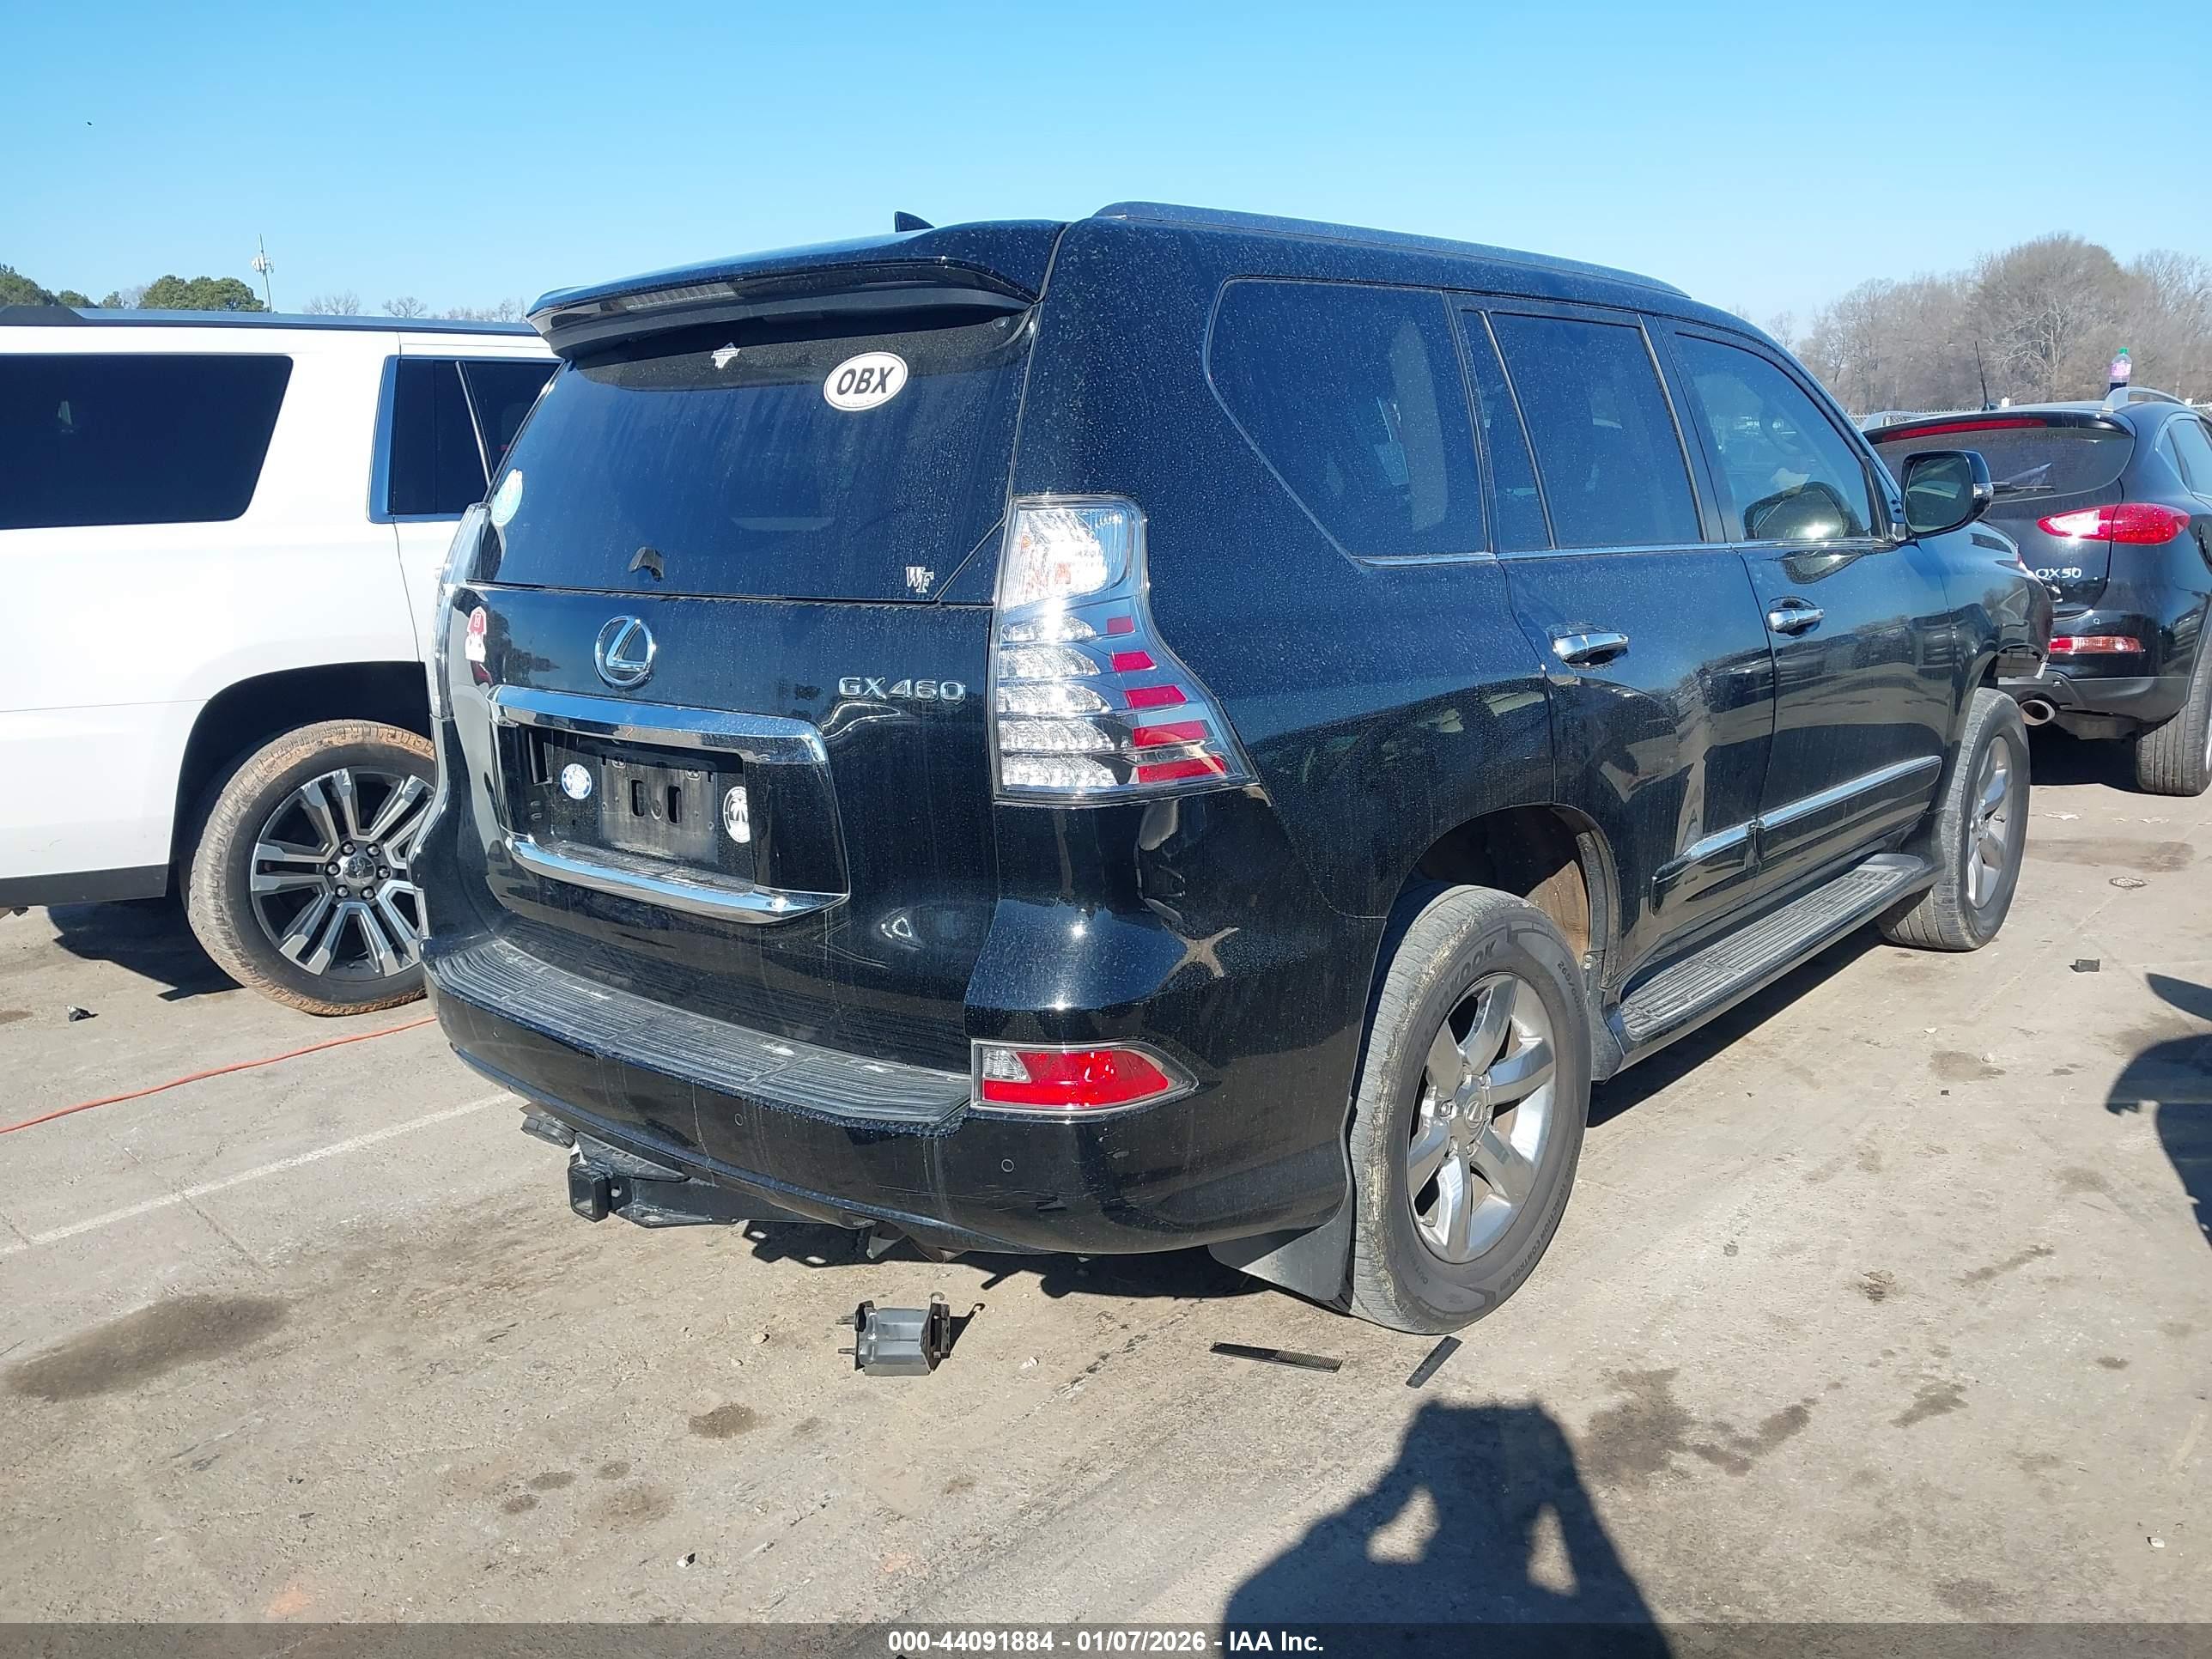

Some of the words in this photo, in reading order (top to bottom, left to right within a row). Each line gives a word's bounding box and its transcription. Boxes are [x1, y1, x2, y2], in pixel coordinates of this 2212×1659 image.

[836, 366, 896, 395] OBX
[905, 566, 934, 593] WF
[2035, 567, 2082, 580] QX50
